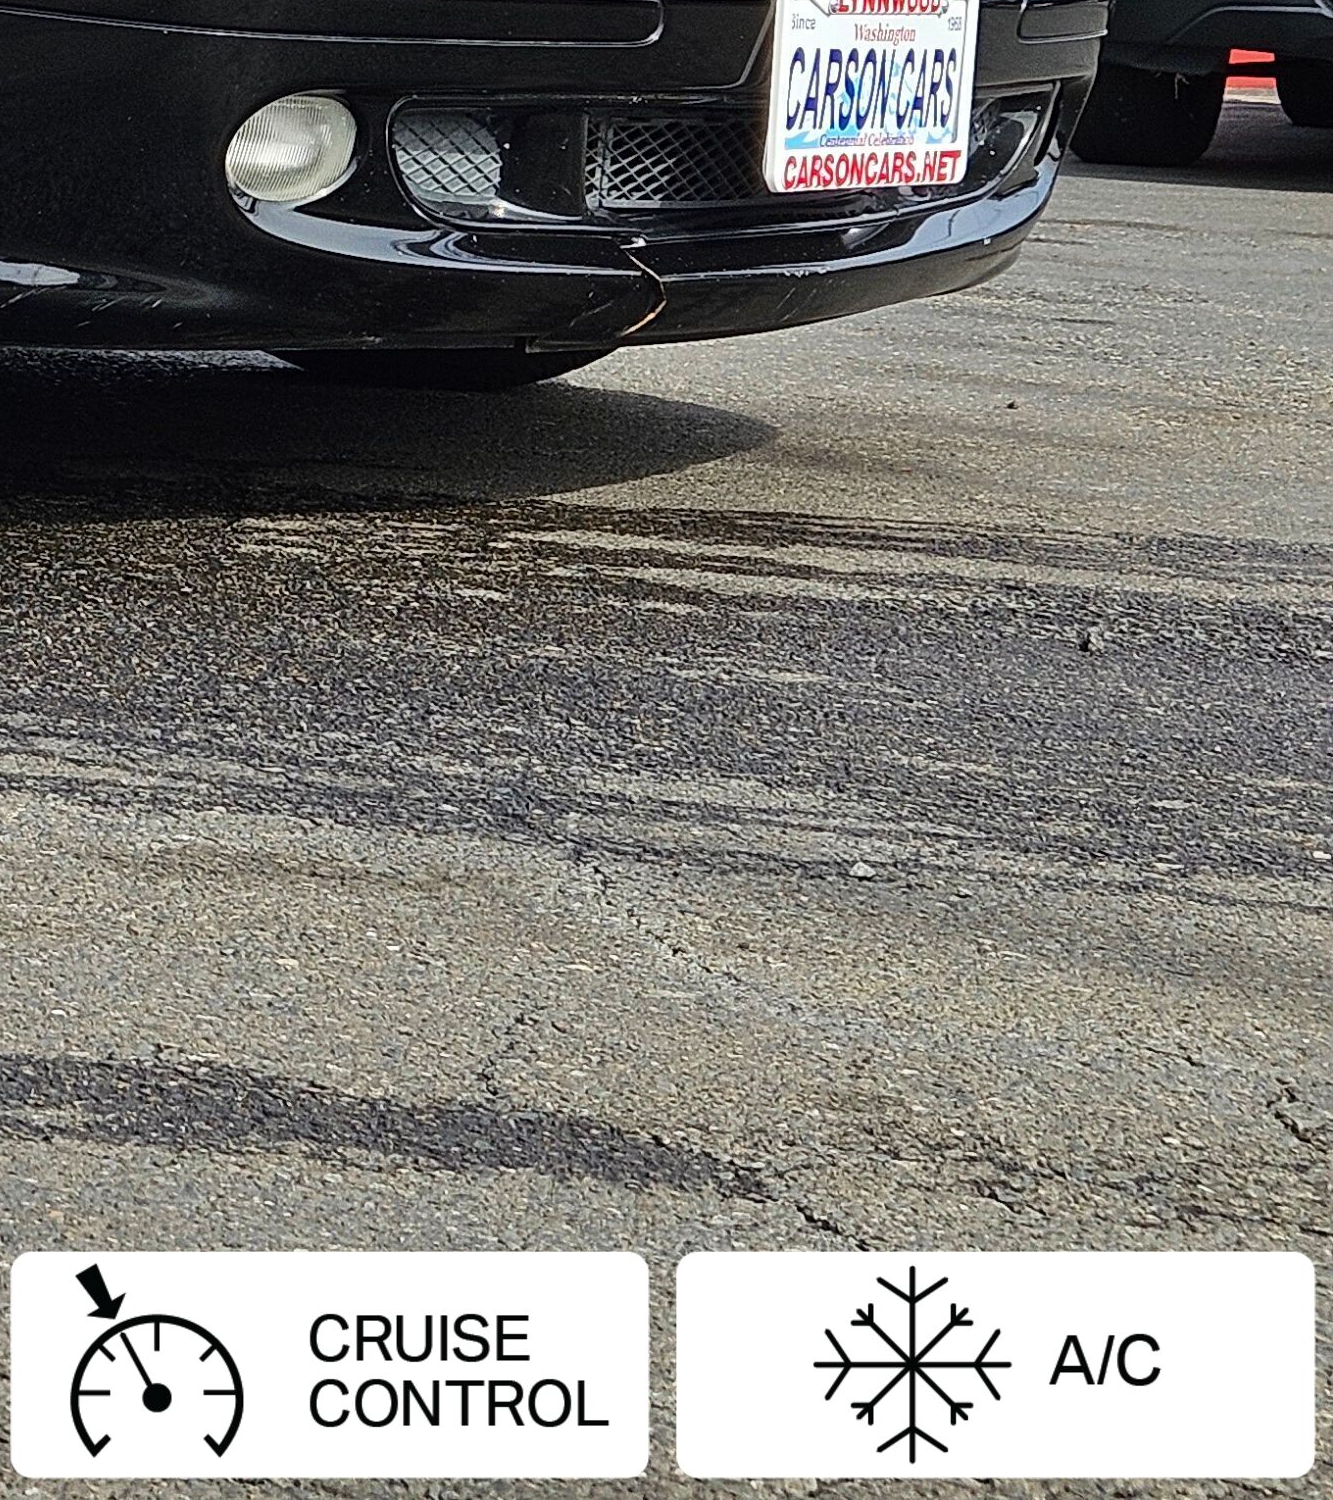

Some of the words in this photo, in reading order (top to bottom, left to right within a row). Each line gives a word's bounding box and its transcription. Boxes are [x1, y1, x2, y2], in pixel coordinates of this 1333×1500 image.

[854, 23, 916, 46] Washington
[785, 46, 896, 131] CARSON
[896, 48, 958, 129] CARS
[783, 150, 962, 190] CARSONCARS.NET
